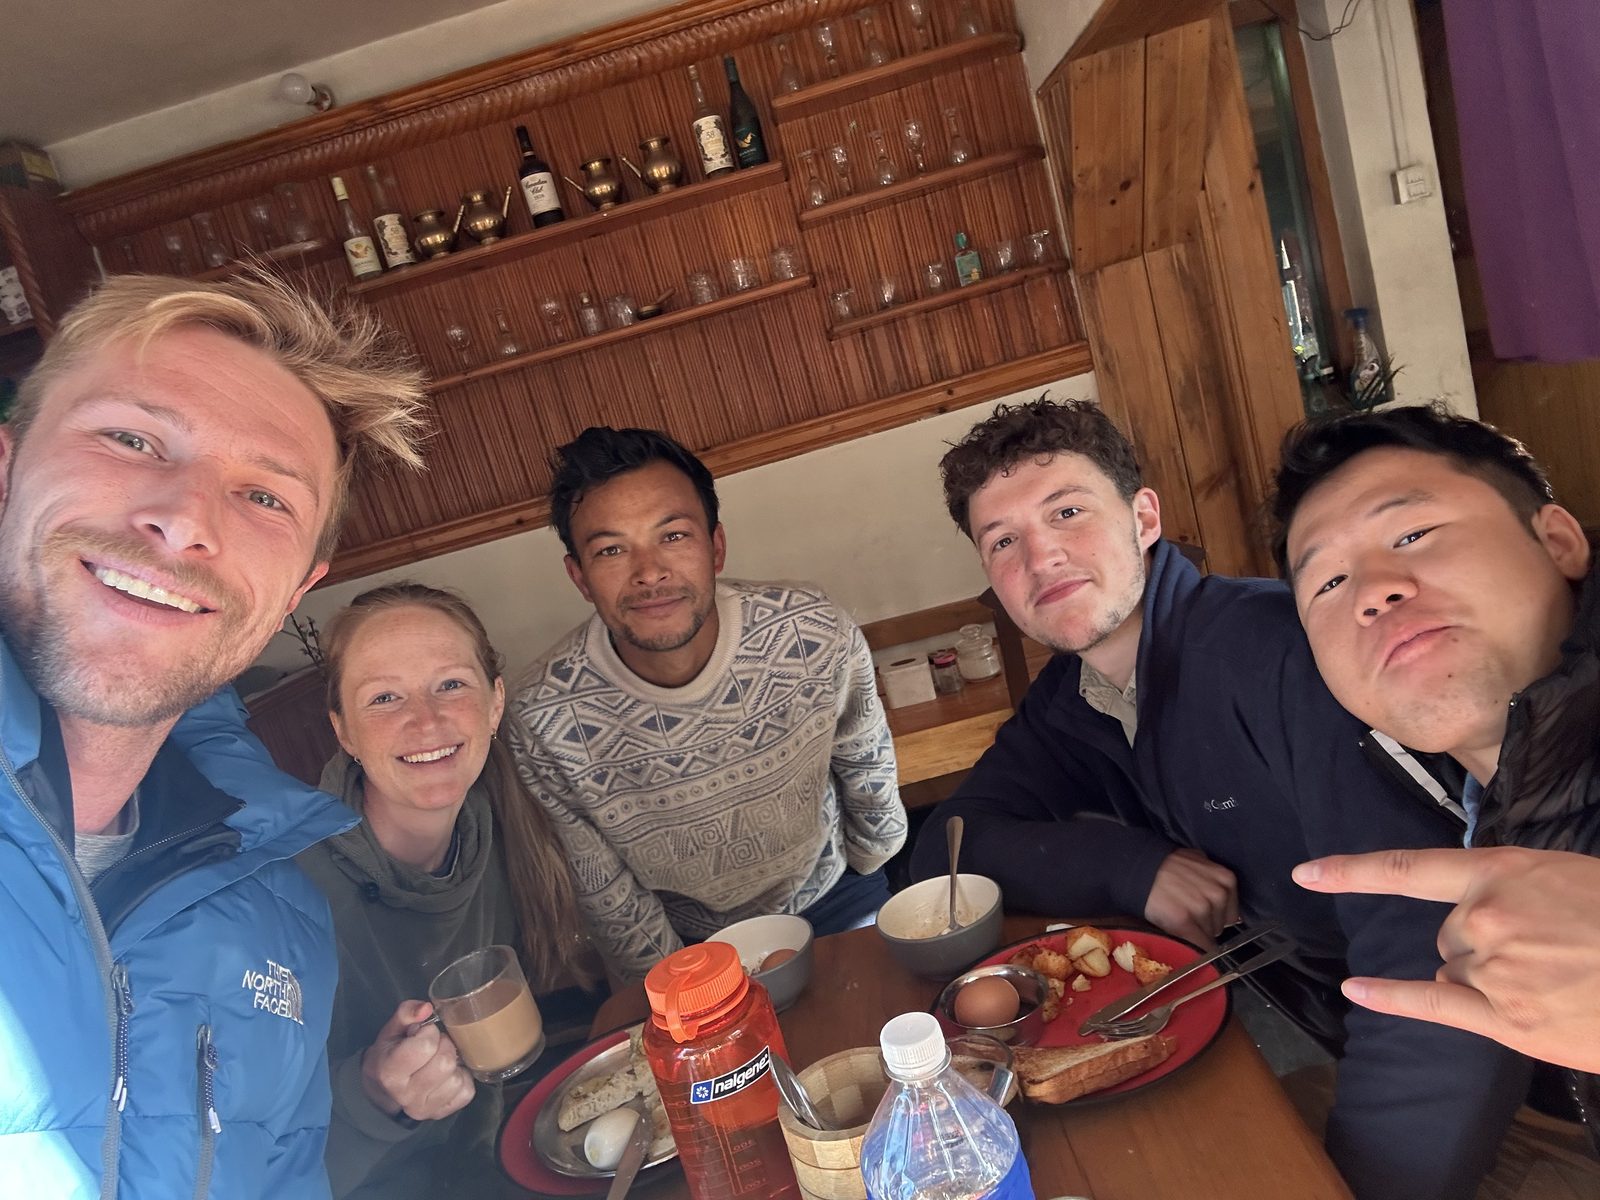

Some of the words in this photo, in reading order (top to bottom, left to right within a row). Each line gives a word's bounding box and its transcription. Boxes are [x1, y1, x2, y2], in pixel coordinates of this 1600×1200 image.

[241, 969, 289, 1000] NORTH
[266, 959, 289, 983] THE
[253, 991, 288, 1018] FACE
[714, 1056, 769, 1095] nalgene
